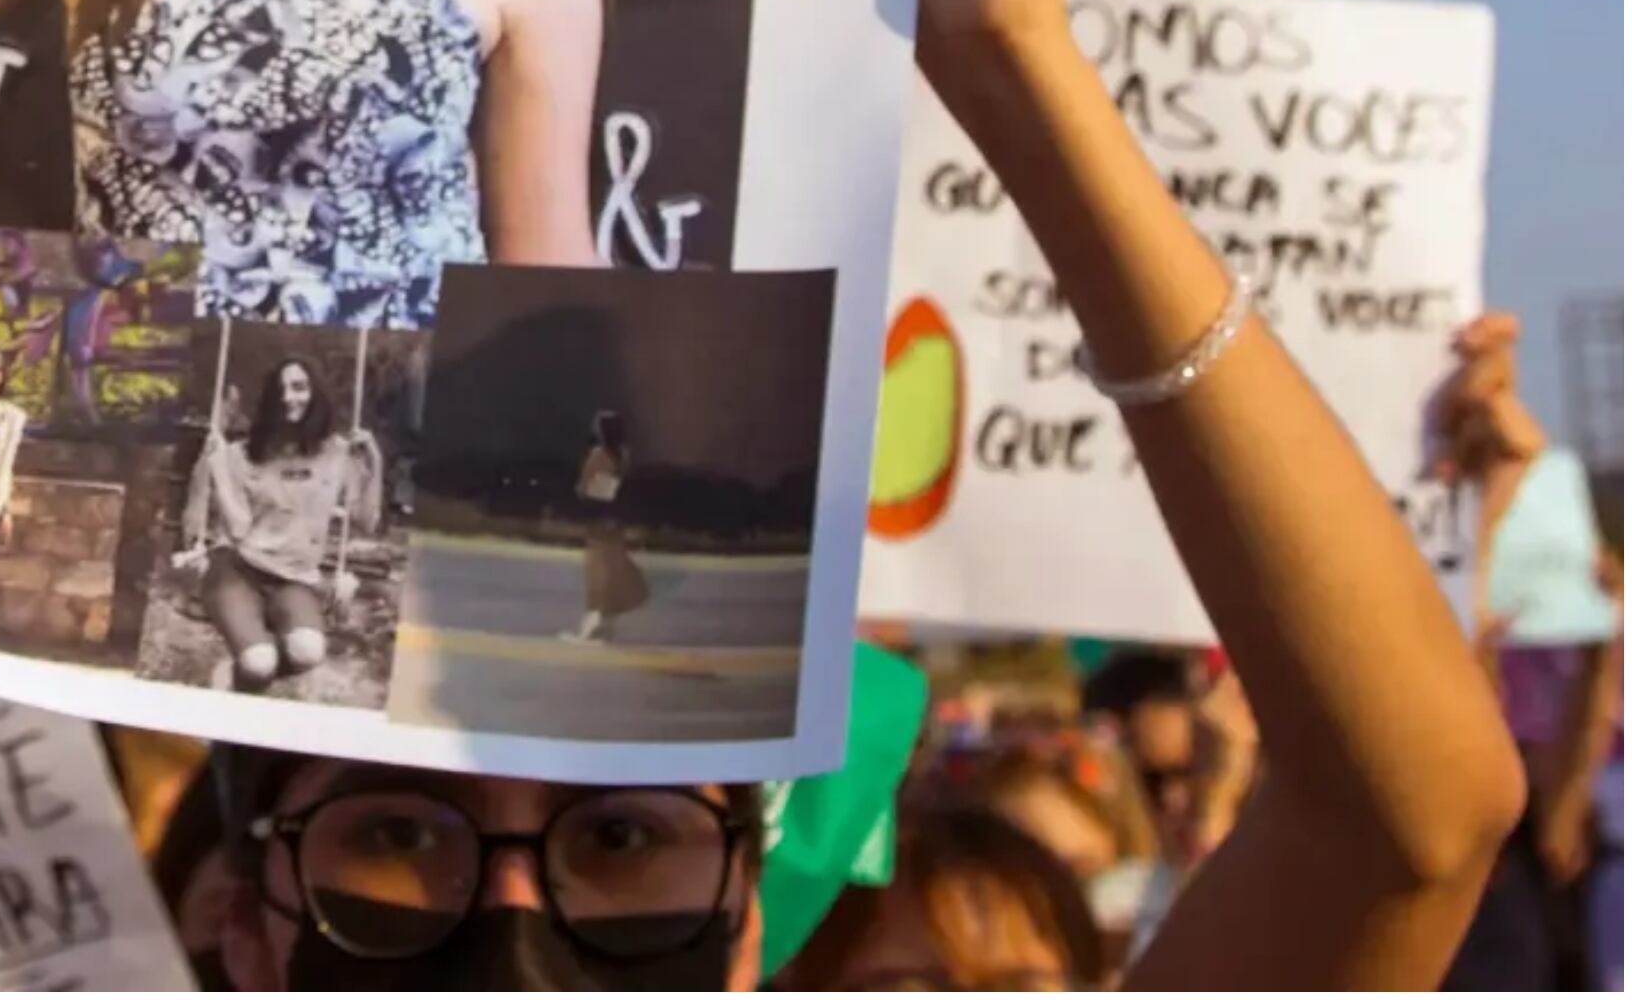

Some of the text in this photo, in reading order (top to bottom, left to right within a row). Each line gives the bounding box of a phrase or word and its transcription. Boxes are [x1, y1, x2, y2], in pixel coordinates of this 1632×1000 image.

[1070, 0, 1312, 74] OMOS
[1250, 90, 1466, 163] VOCES
[974, 404, 1102, 476] QUE
